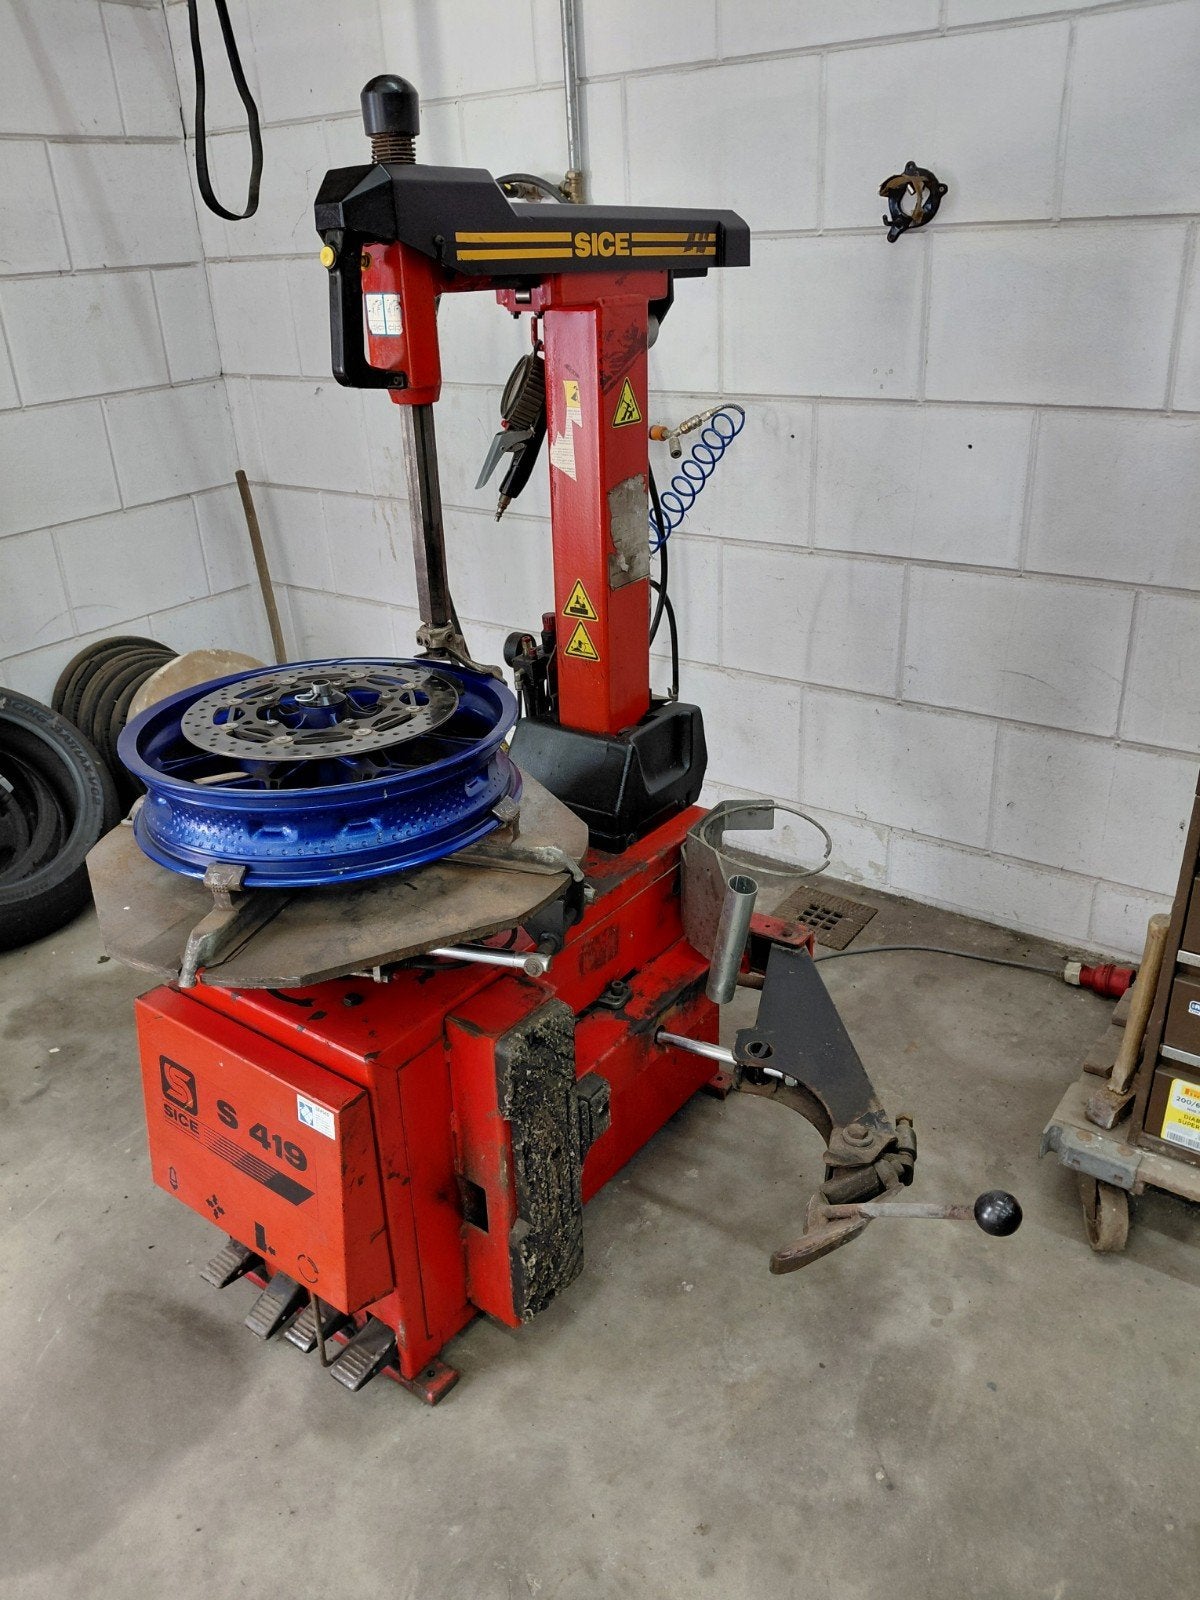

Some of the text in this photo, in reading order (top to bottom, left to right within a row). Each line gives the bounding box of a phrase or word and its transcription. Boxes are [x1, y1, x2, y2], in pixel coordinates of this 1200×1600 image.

[574, 231, 630, 258] SICE
[163, 1102, 200, 1135] SICE
[216, 1099, 239, 1130] S
[248, 1122, 308, 1172] 419
